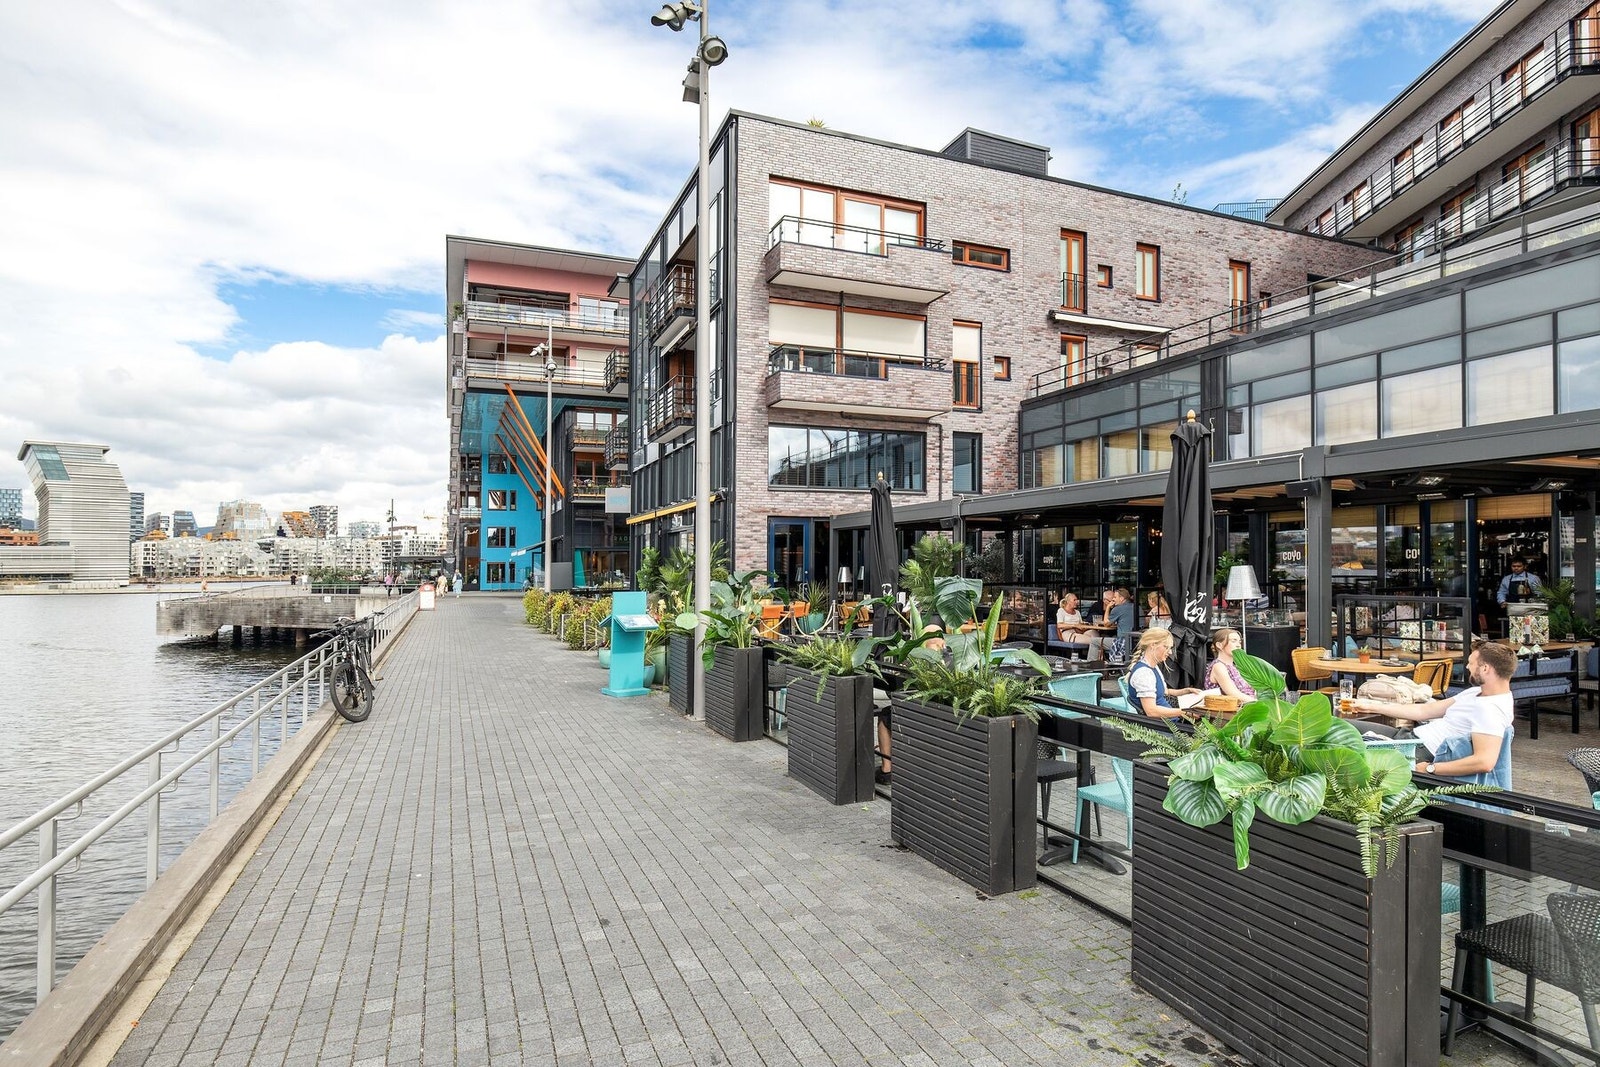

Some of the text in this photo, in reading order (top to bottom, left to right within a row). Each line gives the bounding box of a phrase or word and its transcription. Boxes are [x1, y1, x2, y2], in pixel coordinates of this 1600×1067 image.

[1043, 556, 1053, 564] COYO
[1113, 554, 1125, 563] COYO
[1282, 550, 1301, 561] COYO
